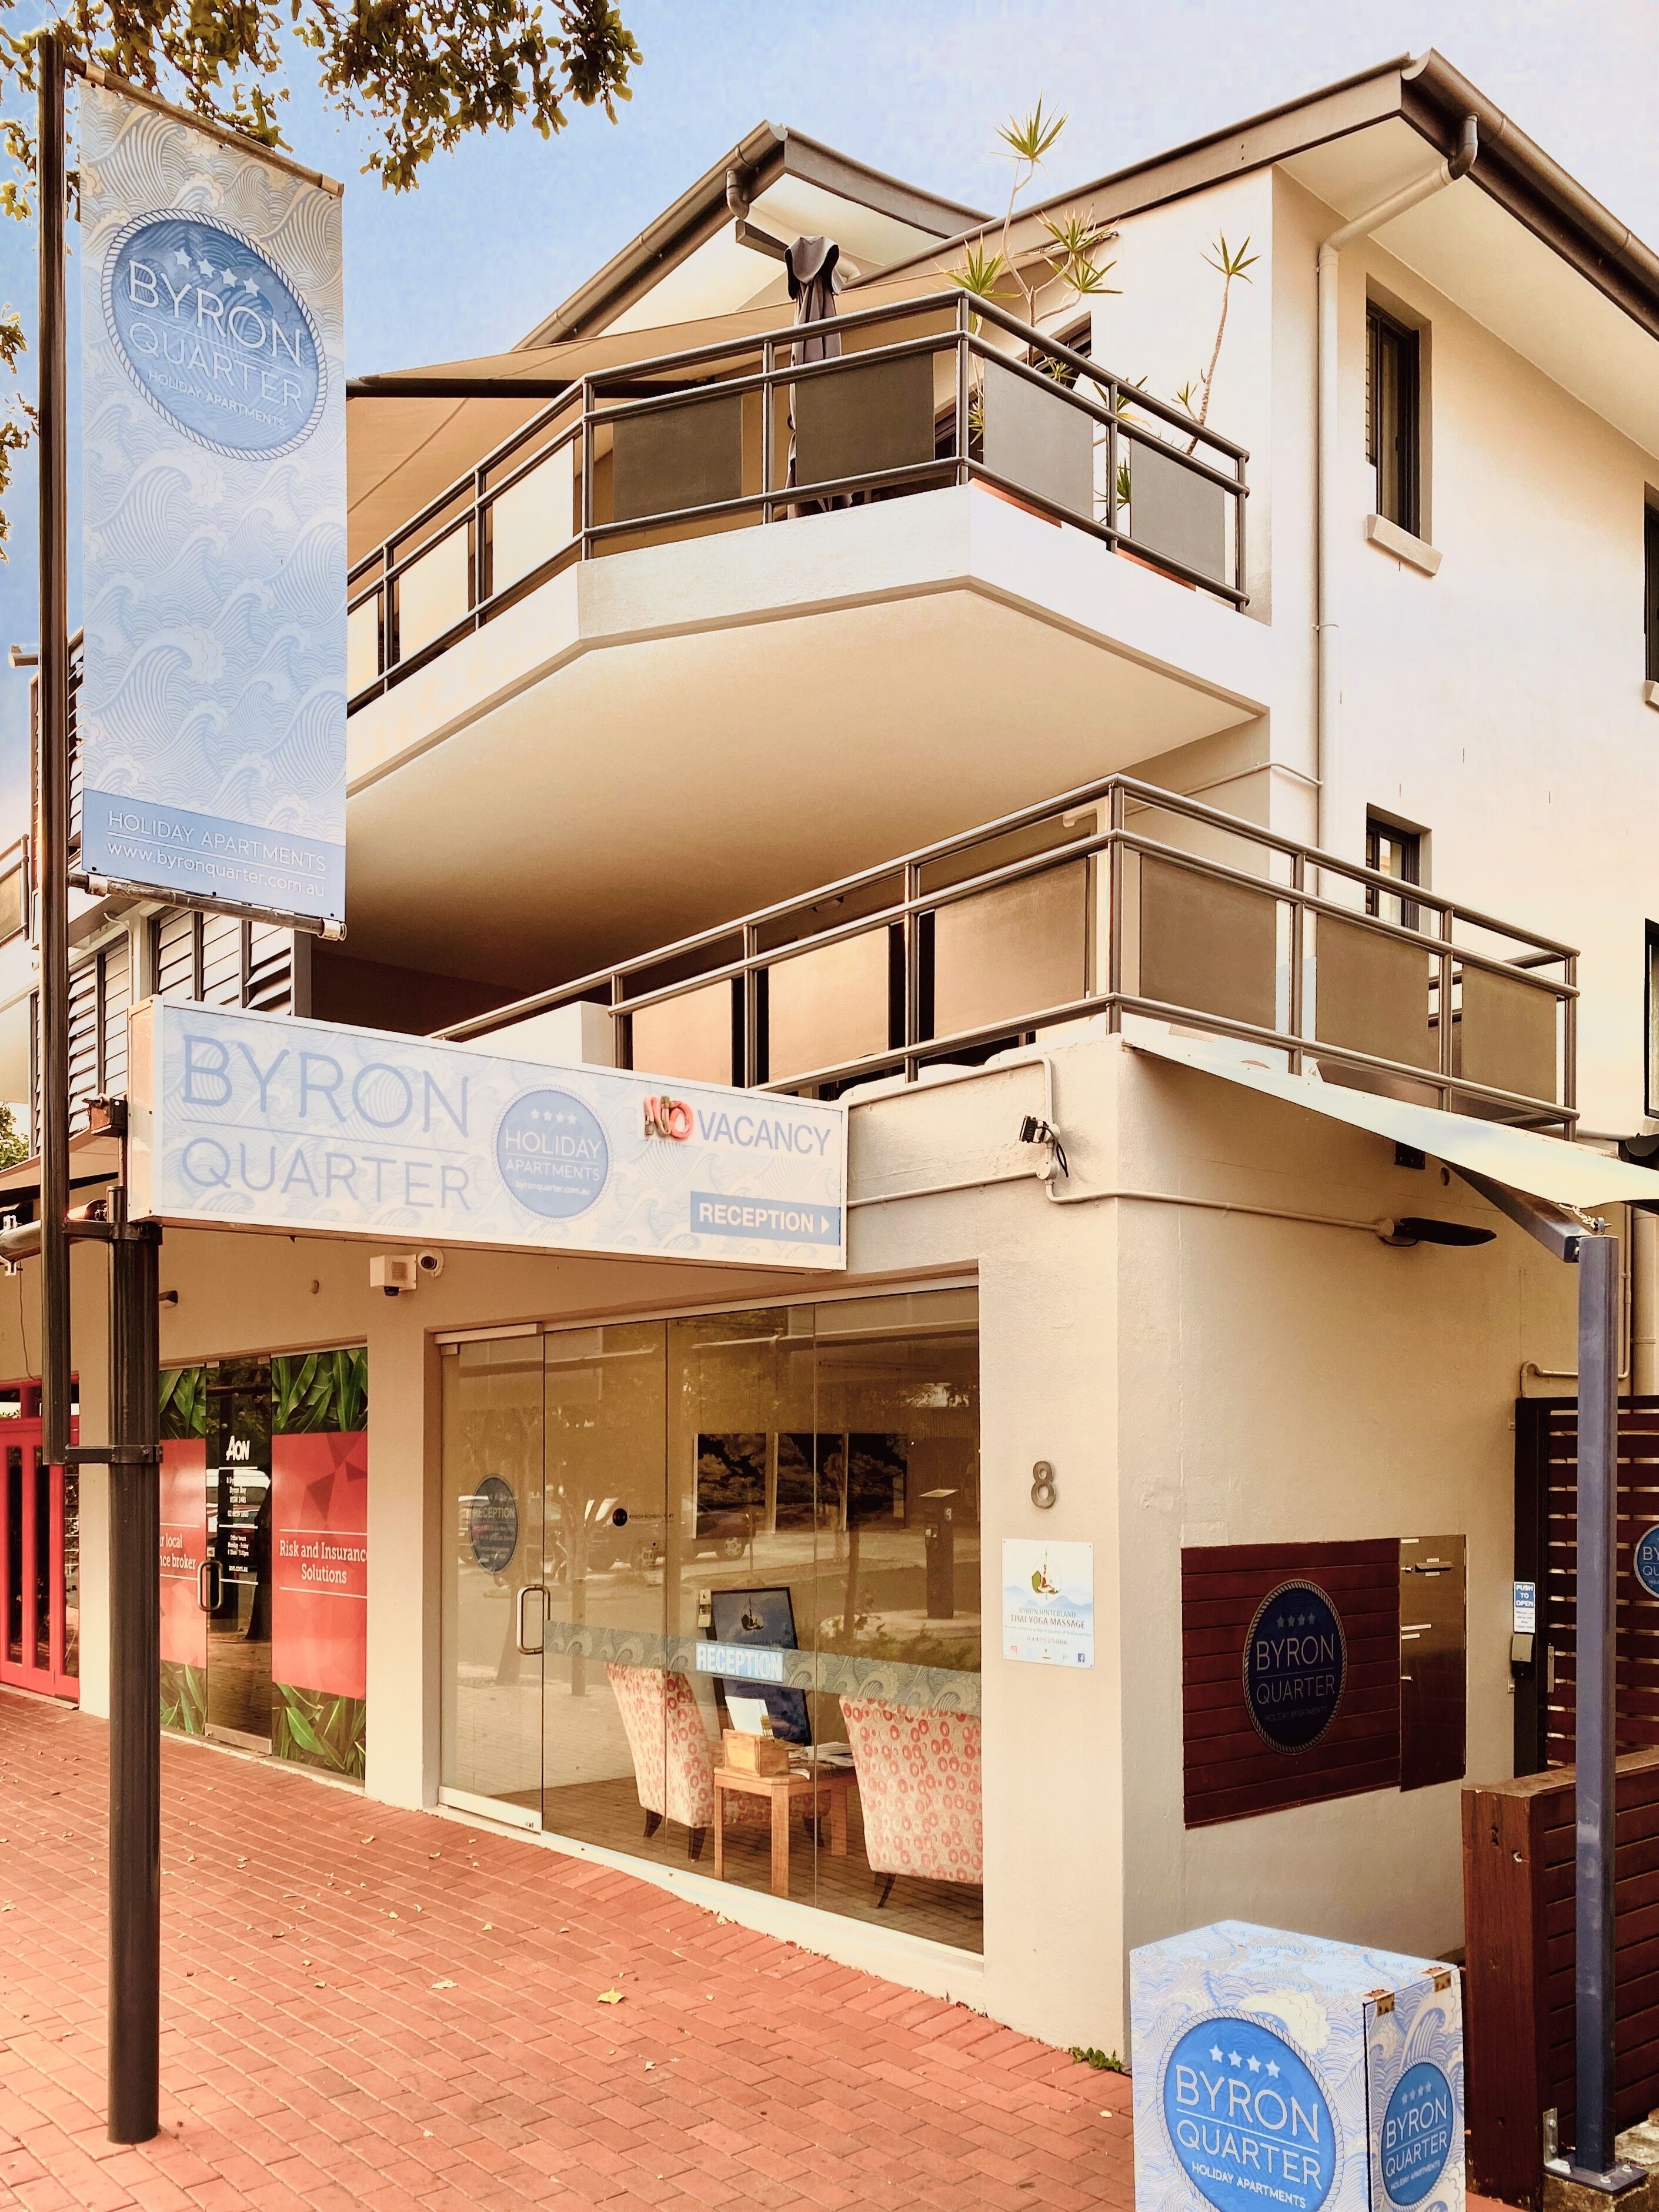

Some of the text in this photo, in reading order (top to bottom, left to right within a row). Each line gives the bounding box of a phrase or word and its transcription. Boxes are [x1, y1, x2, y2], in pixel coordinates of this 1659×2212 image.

[129, 260, 301, 367] BYRON
[129, 322, 303, 412] QUARTER
[149, 370, 287, 430] HOLIDAY APARTMENTS
[108, 810, 326, 871] HOLIDAY APARTMENTS
[107, 842, 325, 897] www.byronquarter.com.au
[183, 1034, 469, 1137] BYRON
[505, 1128, 601, 1159] HOLIDAY
[644, 1095, 832, 1156] NO VACANCY
[182, 1138, 470, 1211] QUARTER
[506, 1158, 600, 1181] APARTMENTS
[515, 1180, 590, 1195] byronquarter.com.au
[700, 1202, 814, 1233] RECEPTION
[1031, 1461, 1056, 1509] 8
[472, 1506, 515, 1518] RECEPTION
[165, 1532, 183, 1549] local
[279, 1539, 367, 1562] Risk and Insuranc
[171, 1552, 196, 1570] broker
[301, 1563, 347, 1584] Solutions
[1010, 1614, 1085, 1629] THAI YOGA MASSAGE
[1019, 1606, 1076, 1618] BYRON HINTERLAND
[697, 1646, 782, 1680] RECEPTION
[1256, 1633, 1334, 1671] BYRON
[1256, 1675, 1335, 1705] QUARTER
[1265, 1706, 1327, 1722] HOLIDAY APARTMENTS
[1176, 2064, 1319, 2143] BYRON
[1386, 2093, 1447, 2149] BYRON
[1177, 2120, 1322, 2190] QUARTER
[1386, 2131, 1447, 2177] QUARTER
[1191, 2161, 1306, 2208] HOLIDAY APARTMENTS
[1390, 2160, 1441, 2191] HOLIDAY APARTMENTS
